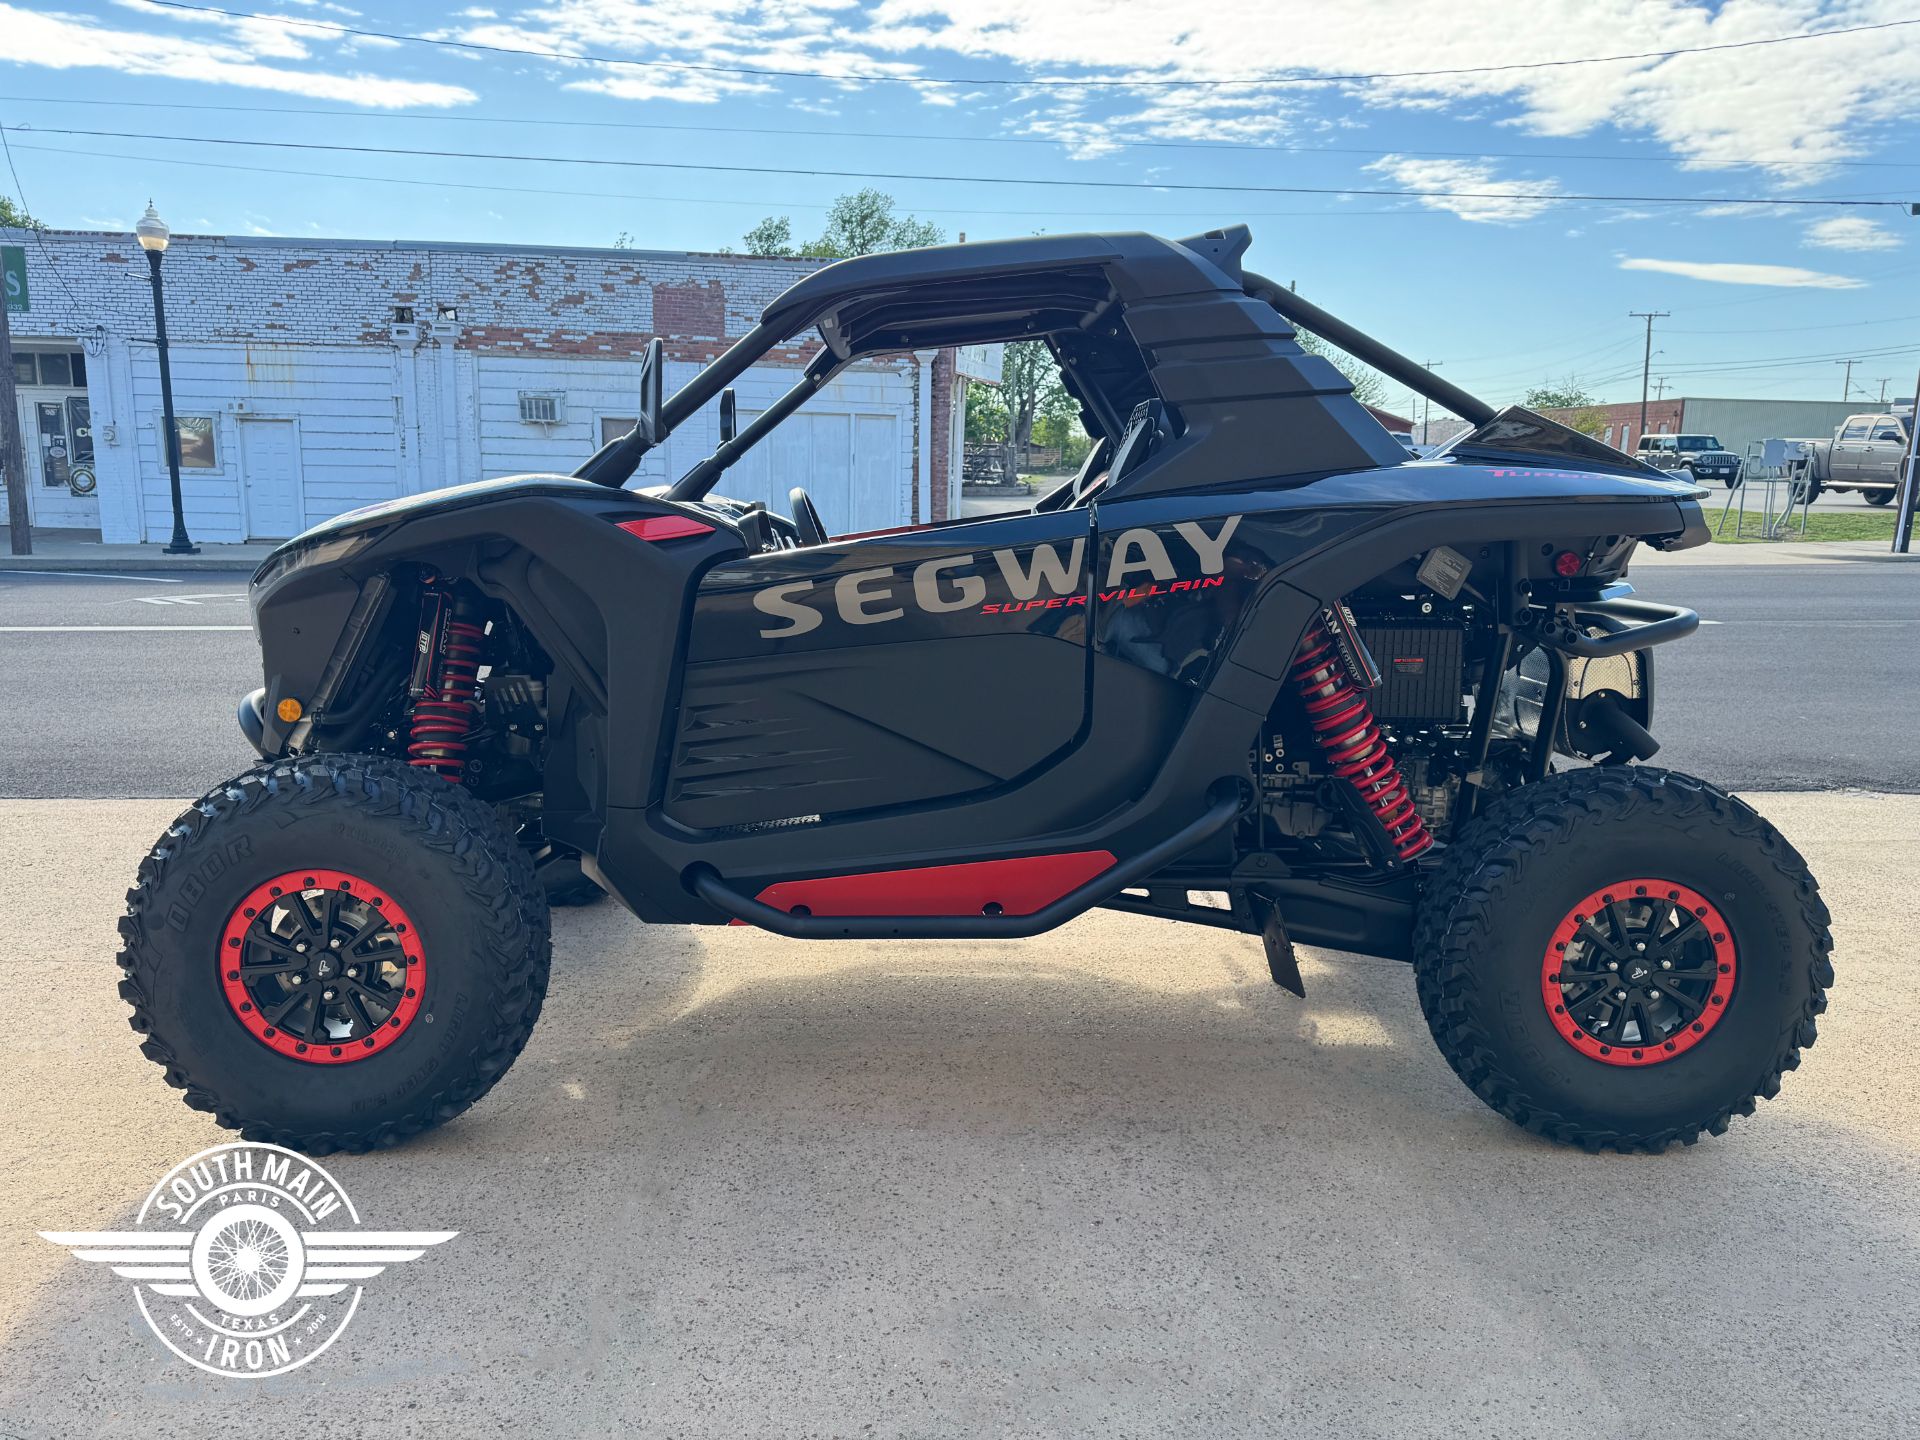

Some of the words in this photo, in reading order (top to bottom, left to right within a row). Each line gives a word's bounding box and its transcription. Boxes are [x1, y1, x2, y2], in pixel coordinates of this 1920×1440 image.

[753, 515, 1243, 639] SEGWAY
[979, 595, 1086, 615] SUPER
[1097, 576, 1225, 602] VILLAIN
[166, 834, 255, 933] OBOR
